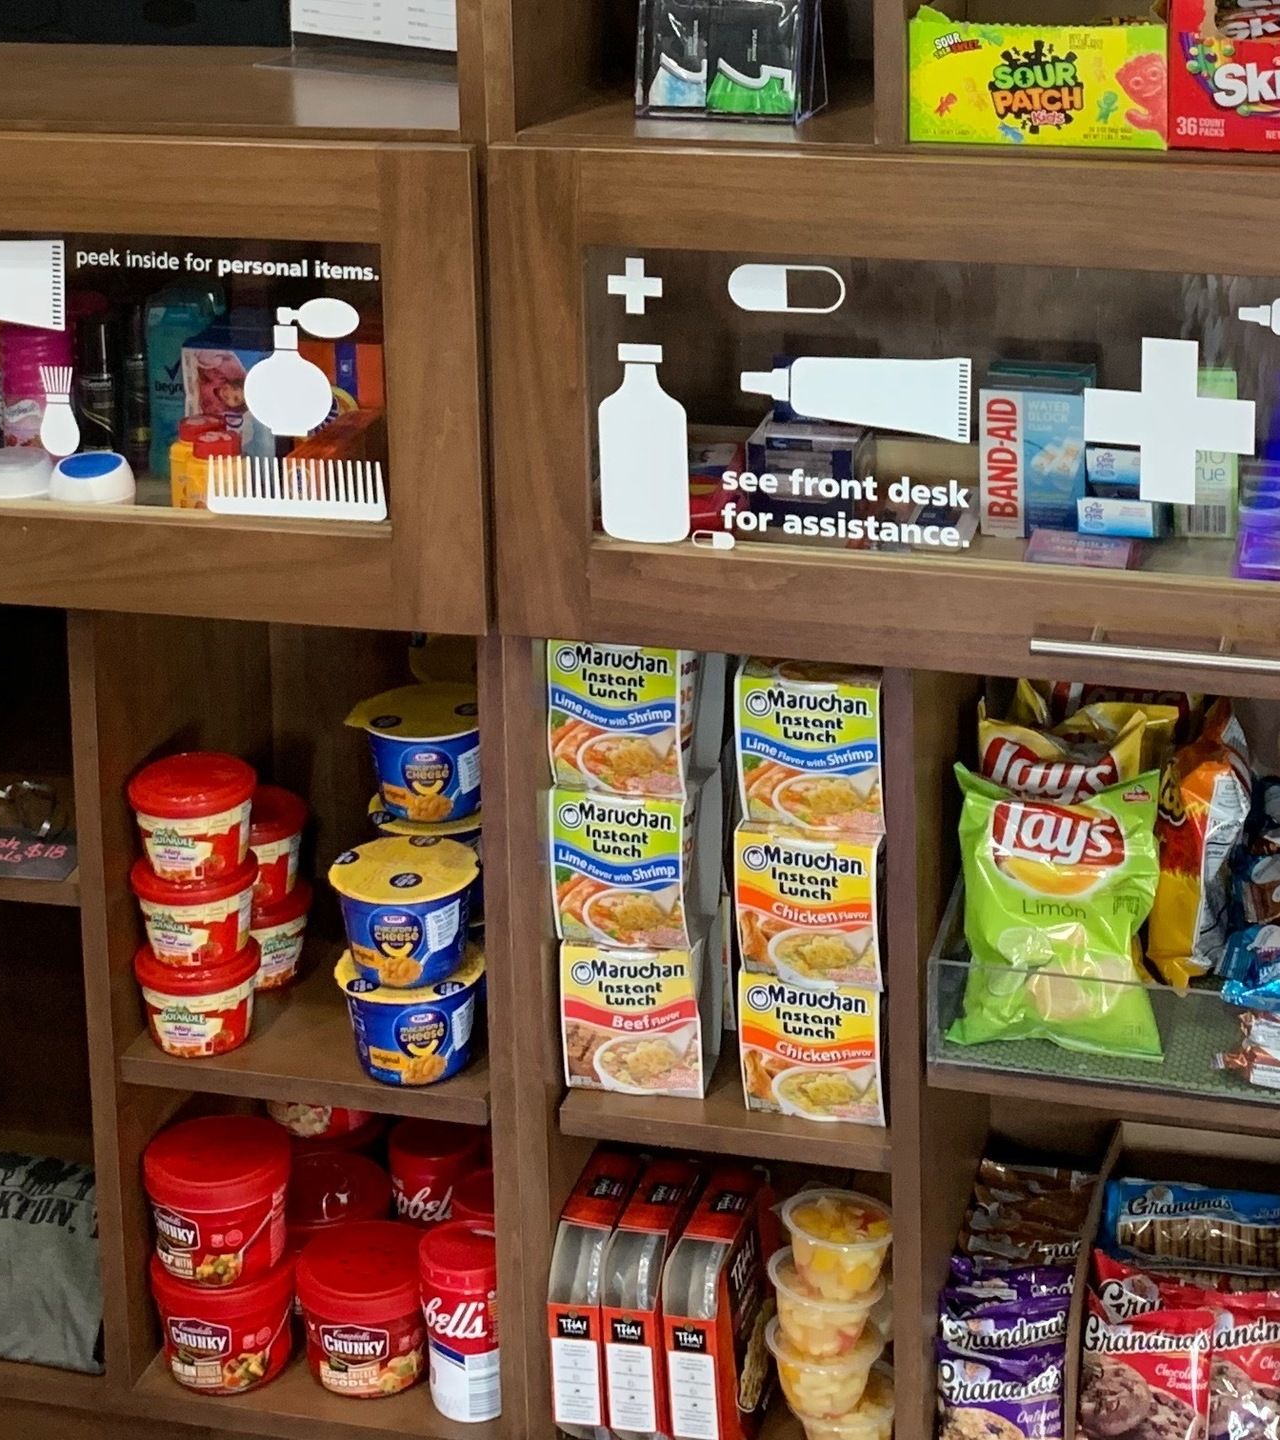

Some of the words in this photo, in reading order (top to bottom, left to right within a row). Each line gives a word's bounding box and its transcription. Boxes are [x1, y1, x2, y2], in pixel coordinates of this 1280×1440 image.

[935, 32, 961, 49] SOUR
[993, 61, 1076, 90] SOUR
[992, 86, 1083, 114] PATCH
[1031, 110, 1065, 125] Kids
[1176, 116, 1198, 136] 36
[1199, 118, 1225, 128] COUNT
[1199, 128, 1225, 138] PACKS
[76, 248, 120, 269] peek
[126, 250, 179, 269] inside
[184, 251, 212, 273] for
[218, 256, 308, 280] personal
[314, 260, 380, 282] items.
[987, 398, 1018, 518] BAND-AID
[722, 470, 777, 493] see
[789, 468, 878, 501] front
[888, 476, 970, 508] desk
[721, 503, 773, 532] for
[783, 507, 970, 548] assistance.
[576, 646, 668, 674] Maruchan
[582, 668, 645, 688] Instant
[589, 686, 638, 702] Lunch
[767, 689, 867, 716] Maruchan
[555, 692, 583, 713] Lime
[582, 708, 608, 725] Flavor
[609, 714, 628, 727] with
[627, 709, 672, 726] Shrimp
[775, 711, 843, 729] Instant
[783, 727, 837, 744] Lunch
[745, 737, 777, 756] Lime
[777, 749, 804, 766] Flavor
[806, 756, 826, 768] with
[826, 749, 874, 766] Shrimp
[579, 802, 671, 830] Maruchan
[586, 824, 648, 844] Instant
[991, 801, 1115, 865] Lay's
[24, 844, 68, 859] $18
[592, 841, 641, 858] Lunch
[763, 844, 862, 875] Maruchan
[558, 848, 587, 869] Lime
[587, 864, 613, 881] Flavor
[613, 871, 632, 883] with
[631, 865, 676, 883] Shrimp
[771, 867, 838, 887] Instant
[779, 881, 832, 901] Lunch
[772, 901, 838, 924] Chicken
[838, 911, 869, 921] Flavor
[591, 960, 684, 979] Maruchan
[598, 981, 662, 995] Instant
[606, 995, 656, 1006] Lunch
[768, 984, 866, 1013] Maruchan
[612, 1014, 650, 1031] Beef
[650, 1011, 681, 1026] Flavor
[775, 1006, 842, 1027] Instant
[783, 1021, 835, 1040] Lunch
[775, 1040, 842, 1062] Chicken
[842, 1049, 872, 1059] Flavor
[559, 1318, 587, 1331] THAI
[613, 1323, 641, 1337] THAI
[171, 1326, 227, 1351] CHUNKY
[324, 1335, 384, 1357] CHUNKY
[675, 1331, 703, 1344] THAI
